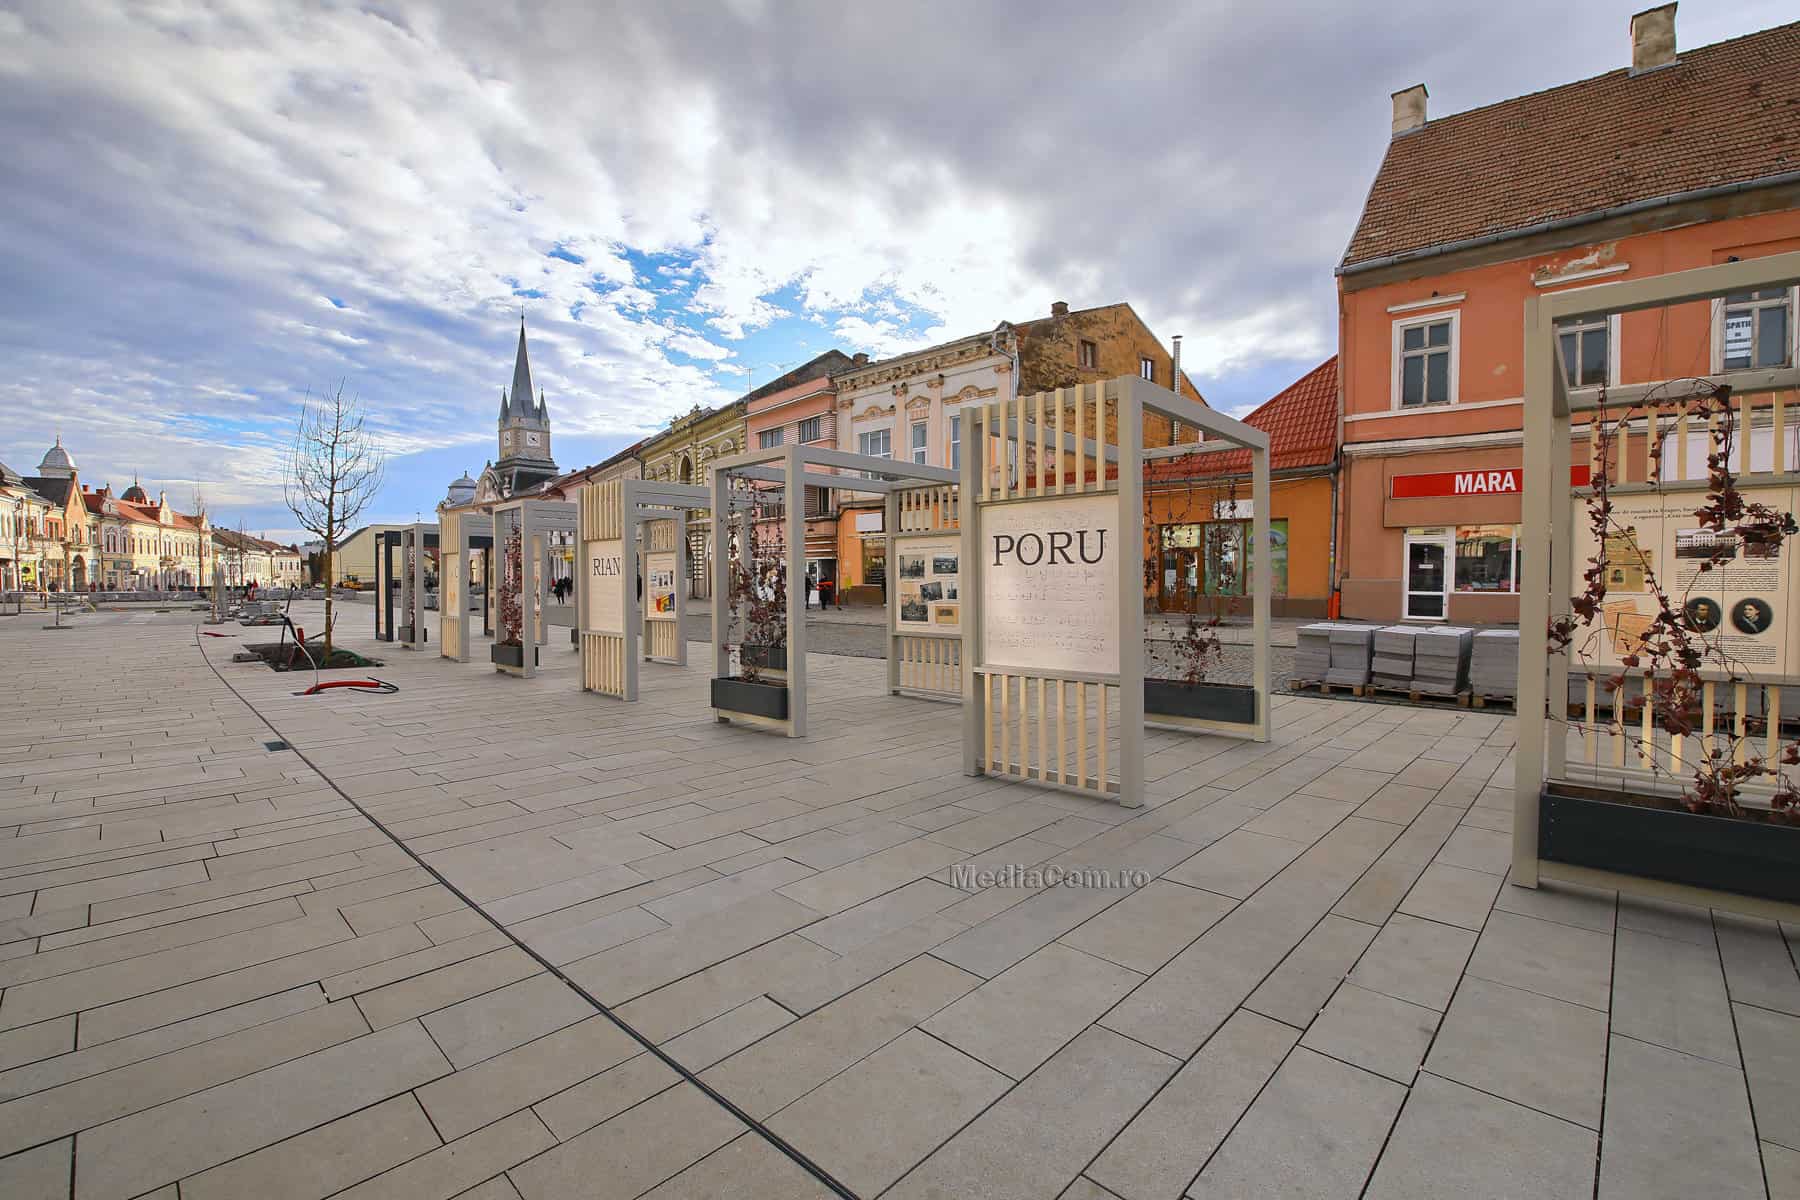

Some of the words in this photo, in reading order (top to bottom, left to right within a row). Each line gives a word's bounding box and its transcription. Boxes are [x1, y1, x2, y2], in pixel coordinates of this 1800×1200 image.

[1455, 471, 1517, 494] MARA
[992, 529, 1108, 567] PORU
[592, 557, 621, 576] RIAN
